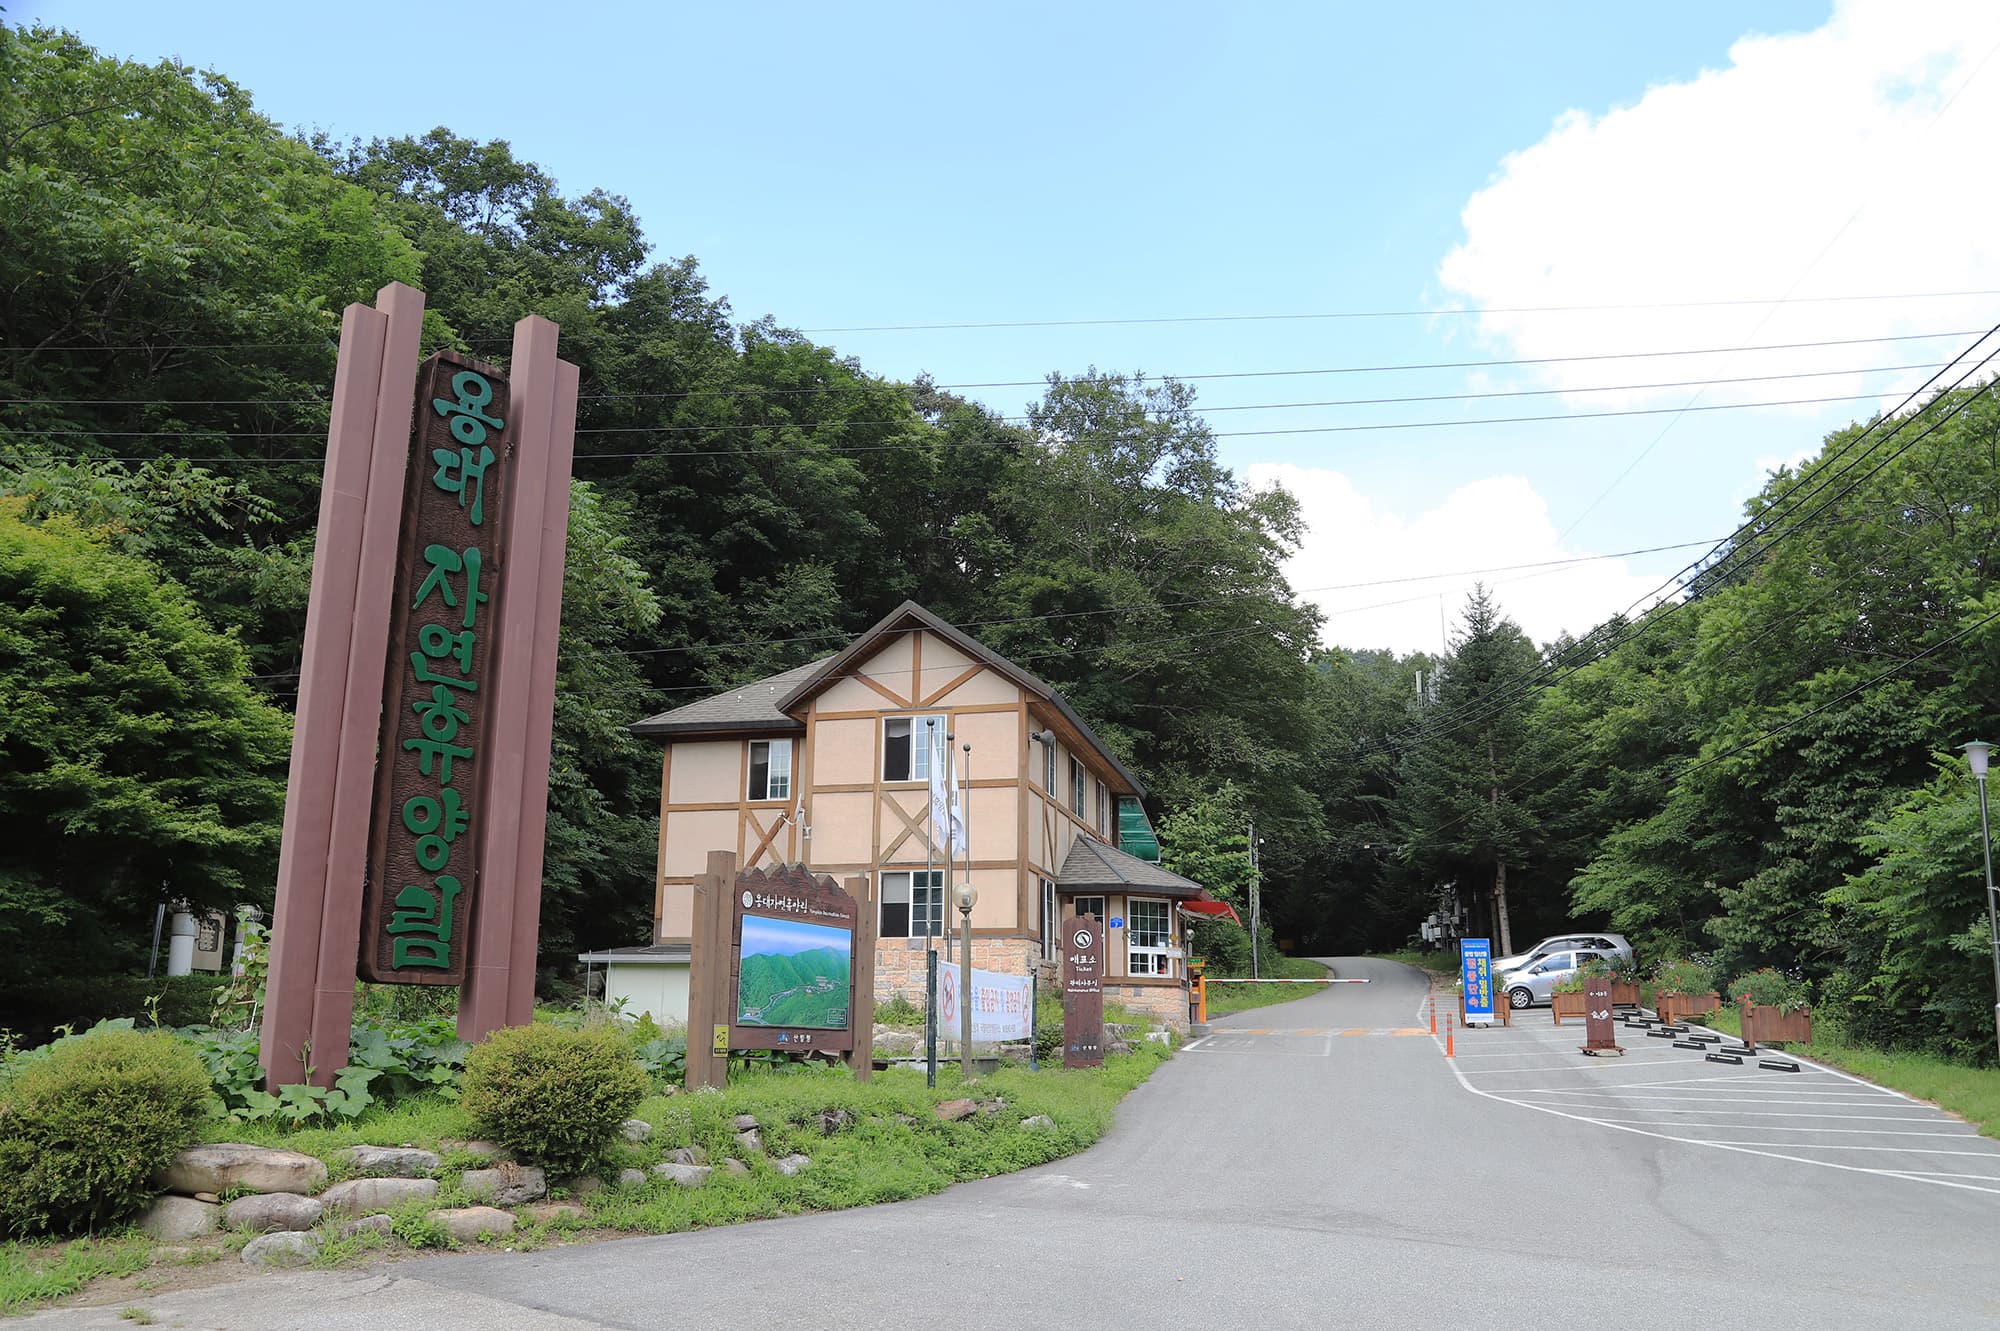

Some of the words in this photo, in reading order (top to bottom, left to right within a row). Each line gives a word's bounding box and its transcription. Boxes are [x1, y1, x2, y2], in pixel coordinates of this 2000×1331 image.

[433, 371, 504, 525] 용대
[386, 546, 488, 969] 자연휴양림
[1070, 953, 1097, 965] 매표소
